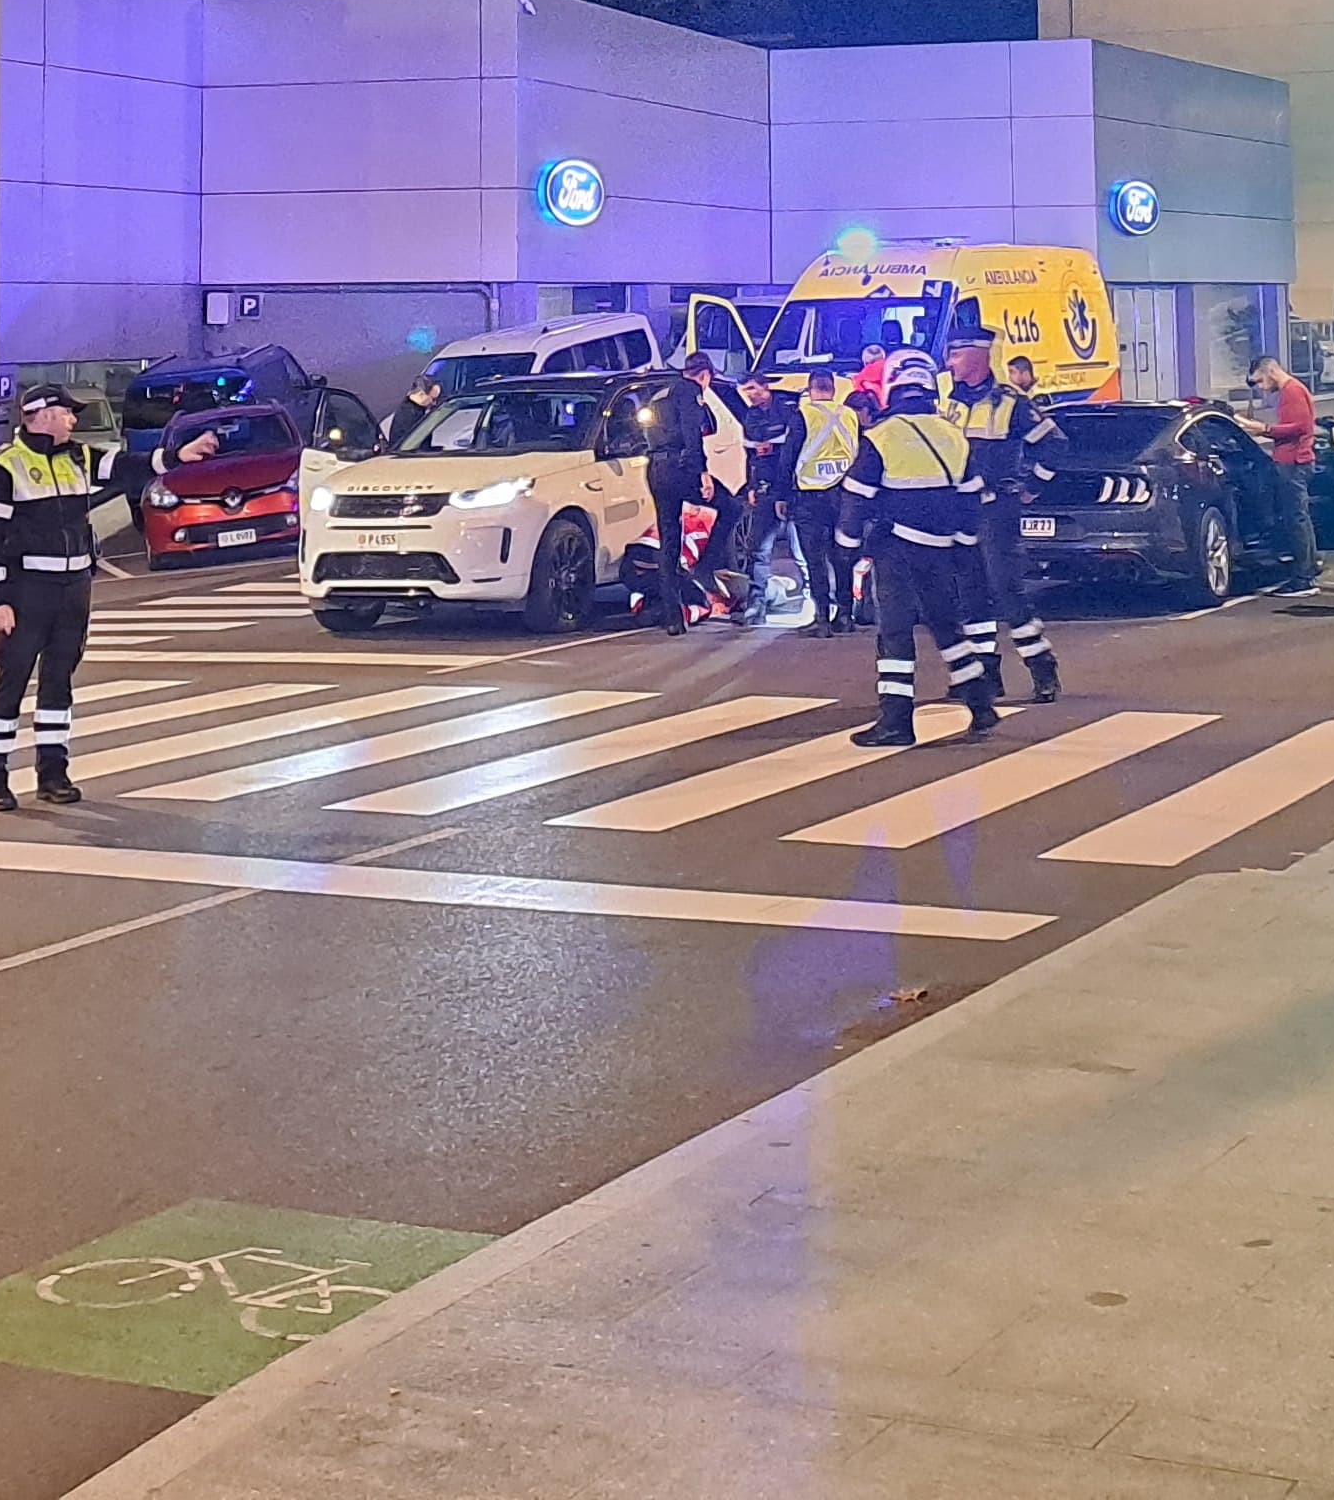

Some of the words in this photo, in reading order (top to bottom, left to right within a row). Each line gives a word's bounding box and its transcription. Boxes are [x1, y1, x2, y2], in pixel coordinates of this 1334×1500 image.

[558, 169, 597, 211] Ford
[1126, 189, 1153, 223] Ford
[1013, 308, 1040, 342] 116
[0, 377, 10, 397] P
